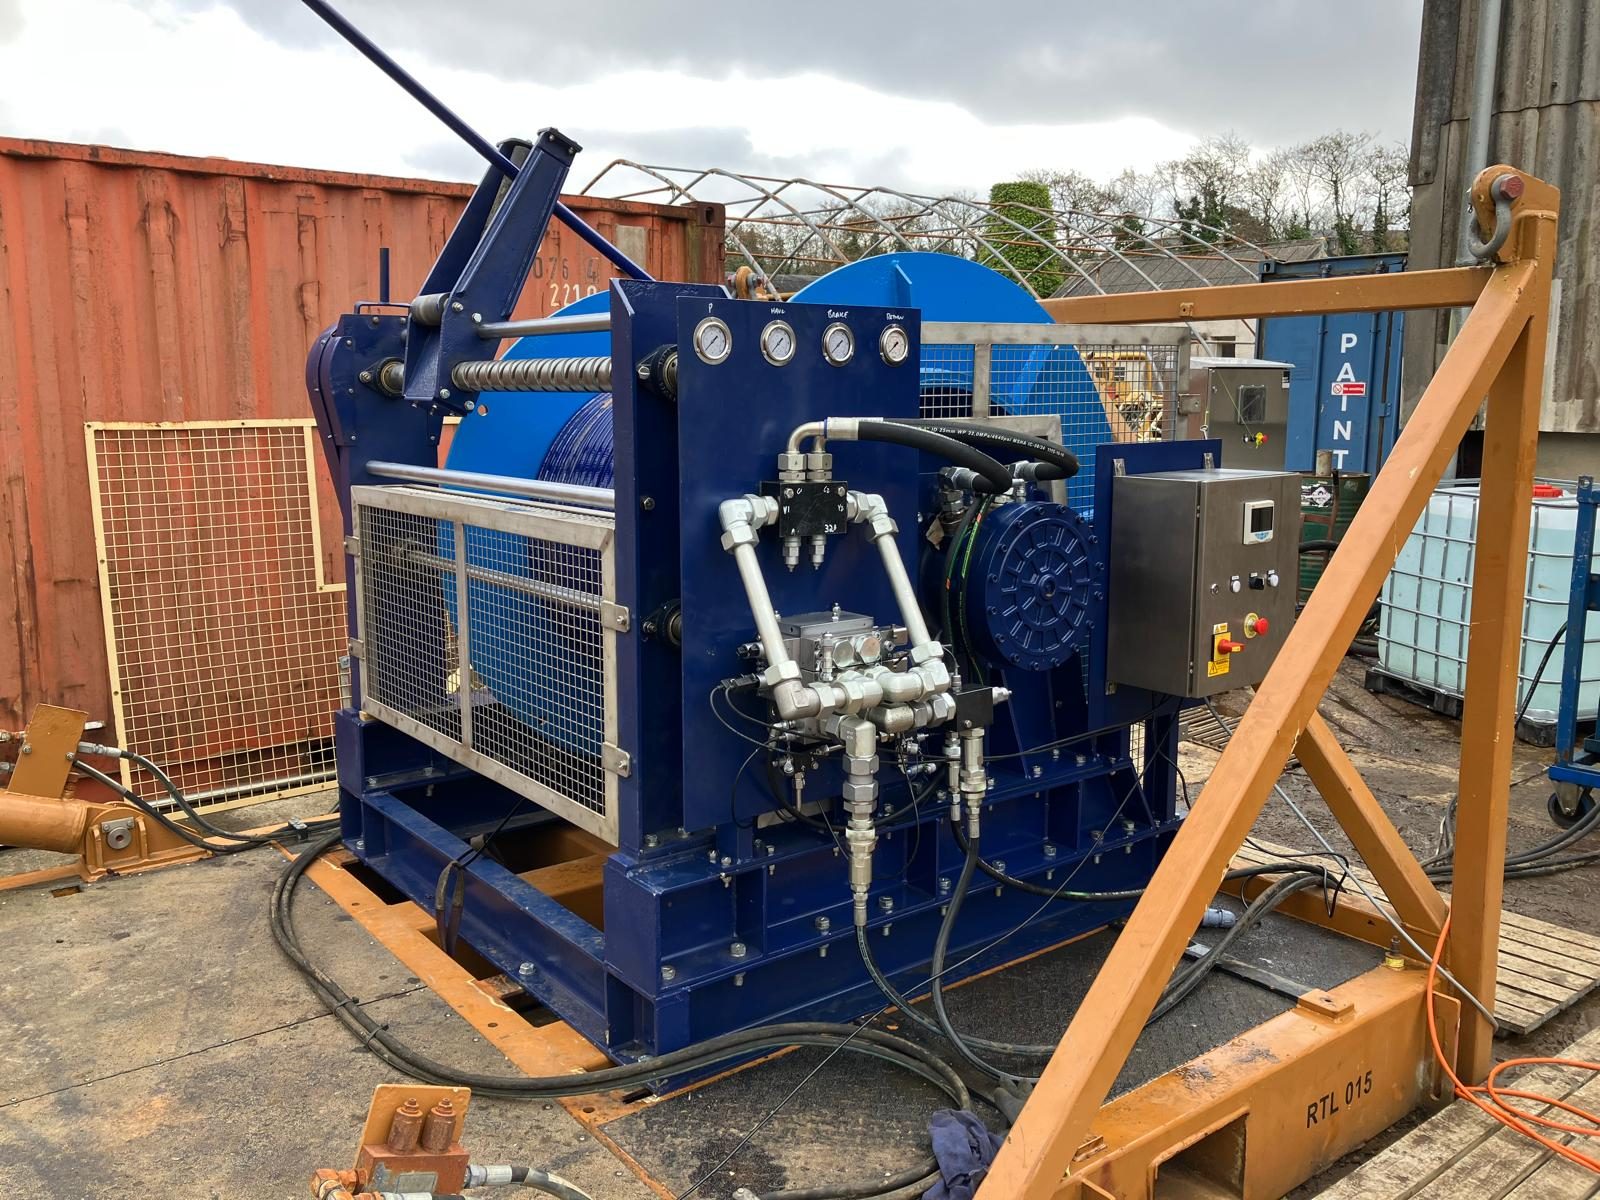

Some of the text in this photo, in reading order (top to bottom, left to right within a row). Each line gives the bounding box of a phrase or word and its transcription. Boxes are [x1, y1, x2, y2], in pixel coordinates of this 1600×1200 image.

[708, 302, 714, 314] P
[827, 309, 849, 319] BRAKE
[1306, 1070, 1373, 1129] RTL 015
